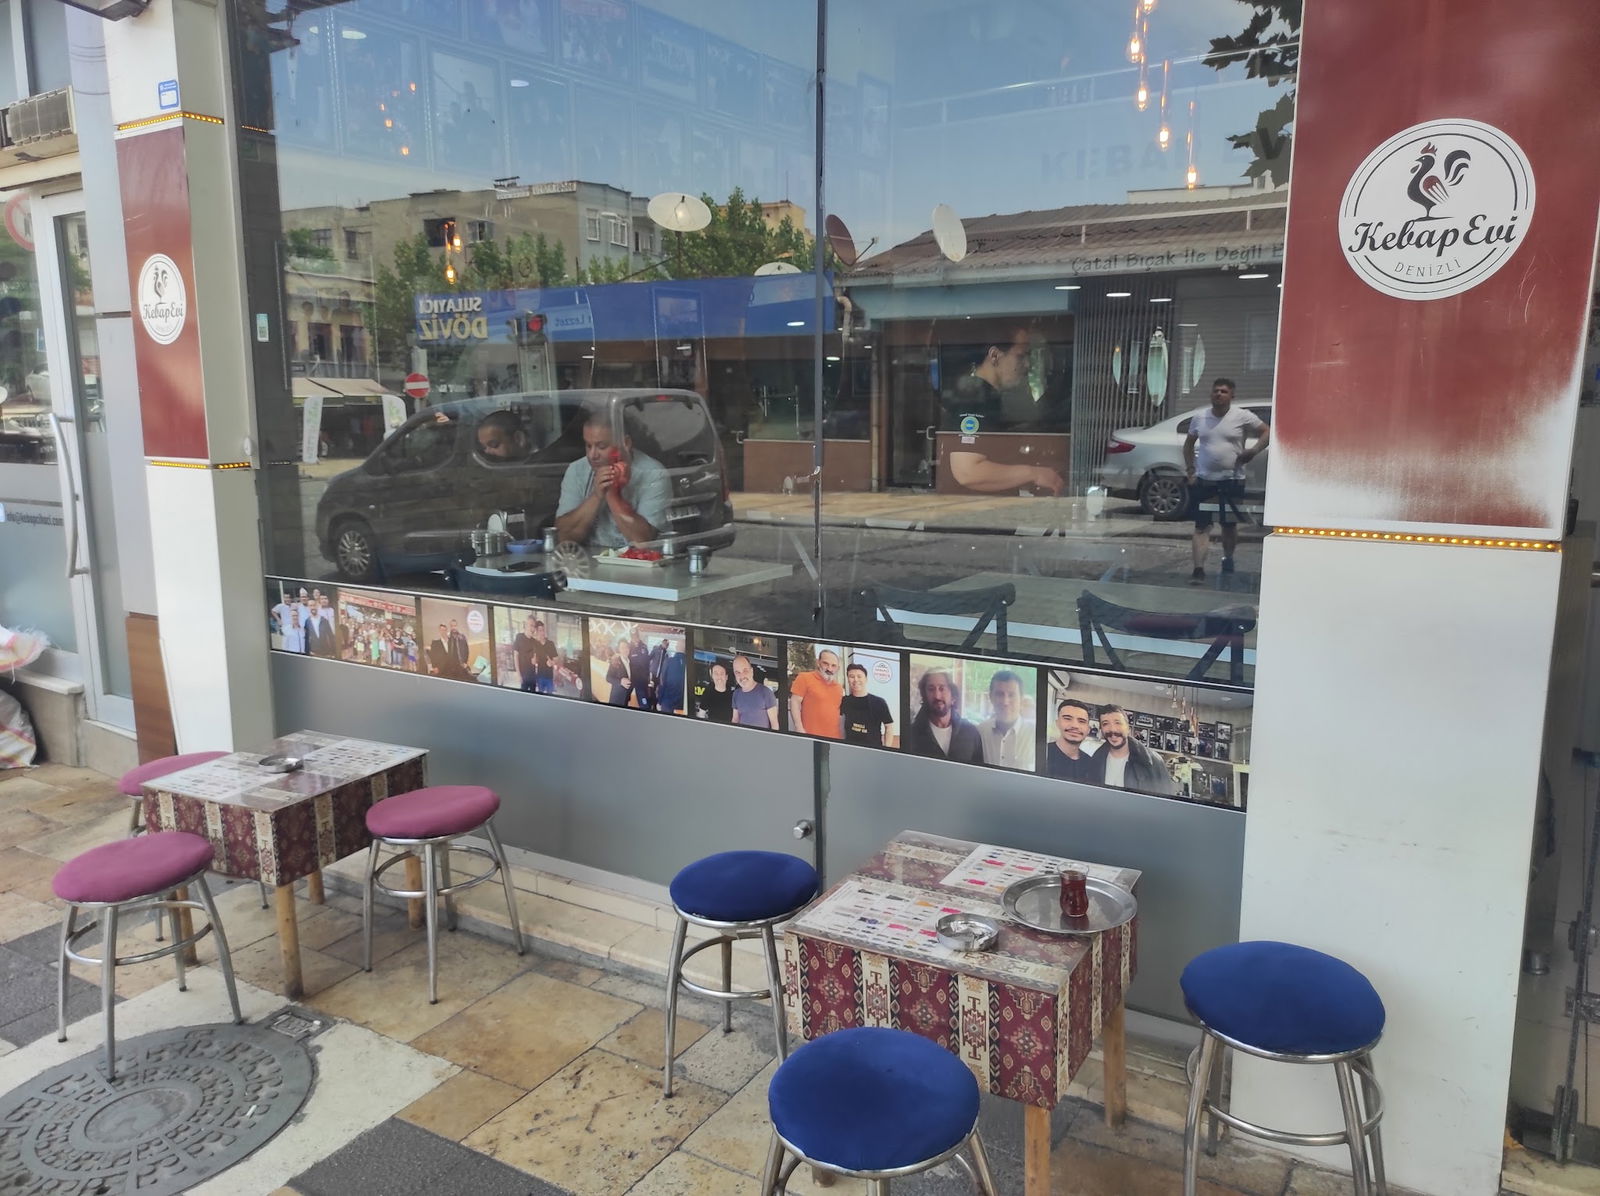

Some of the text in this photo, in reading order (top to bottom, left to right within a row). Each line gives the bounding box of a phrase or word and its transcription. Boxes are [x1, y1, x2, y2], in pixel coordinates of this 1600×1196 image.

[1348, 214, 1518, 257] Kebap Evi
[1071, 254, 1119, 277] Çatal
[1126, 250, 1175, 272] Bıçak
[1394, 258, 1462, 277] DENİZLİ
[143, 302, 170, 323] Kebap
